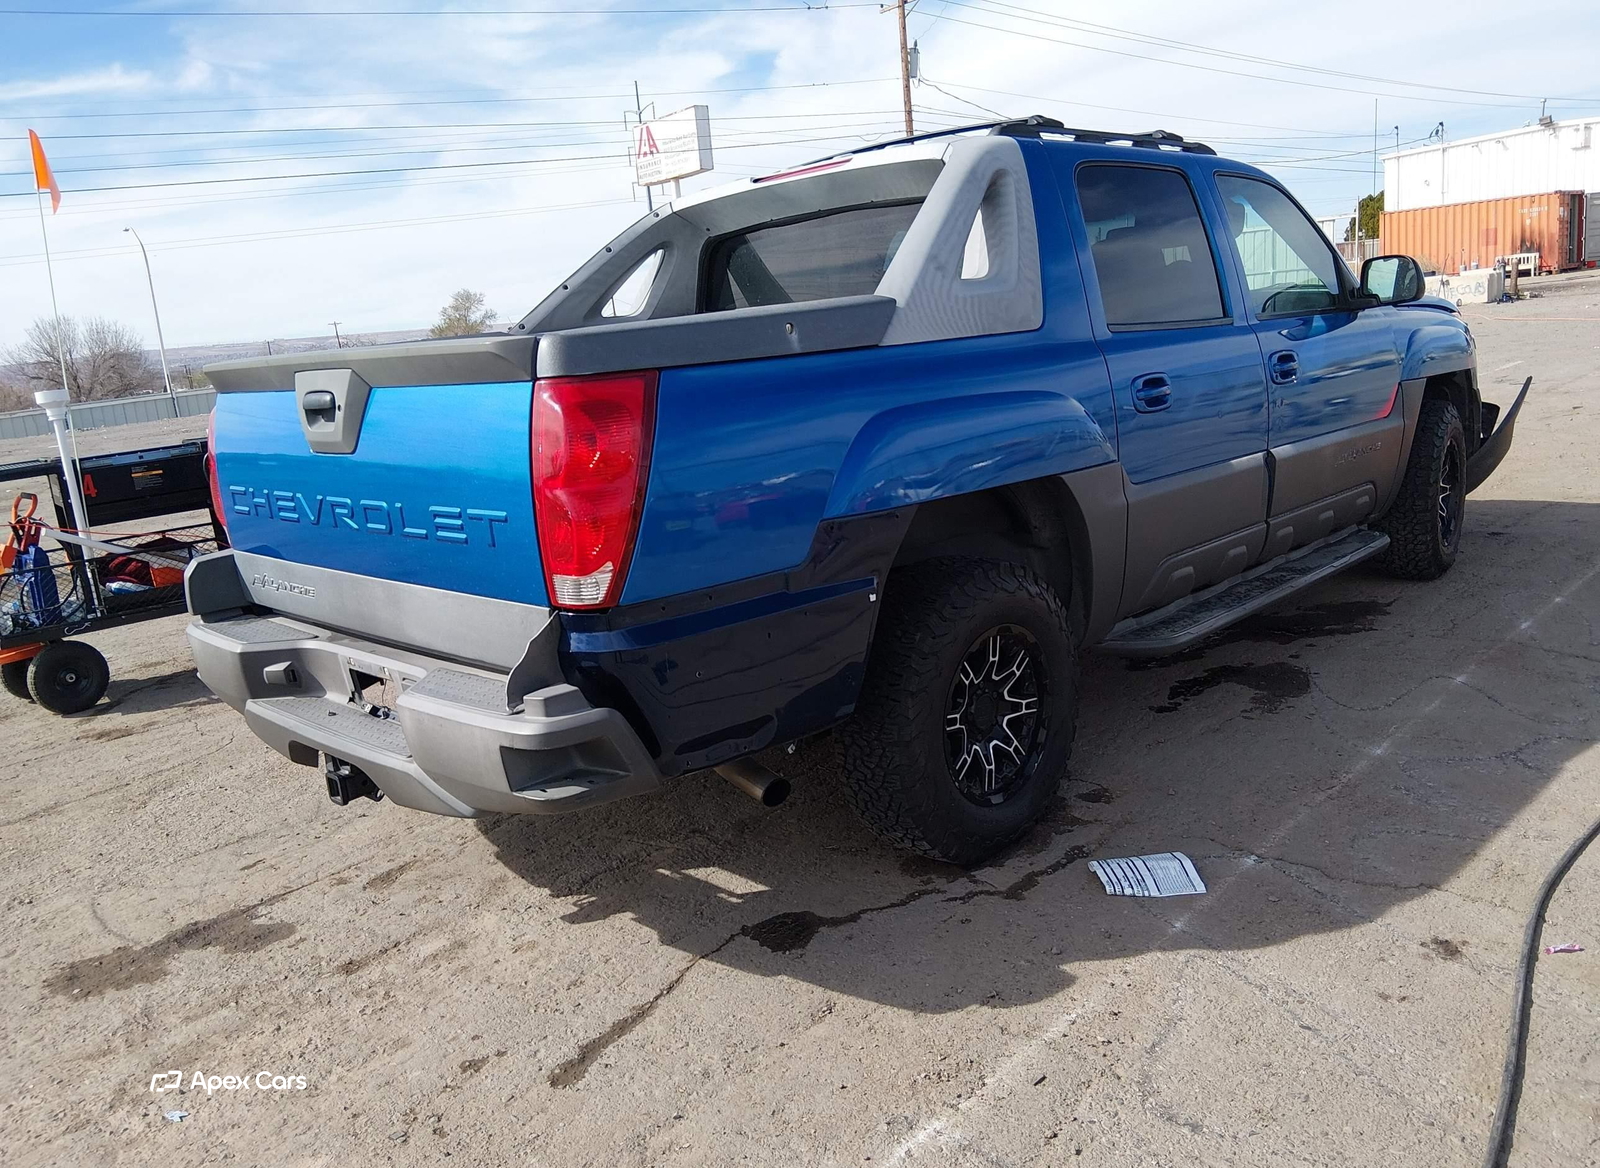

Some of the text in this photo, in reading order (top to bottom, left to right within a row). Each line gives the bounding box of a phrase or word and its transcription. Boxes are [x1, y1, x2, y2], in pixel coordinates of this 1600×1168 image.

[83, 473, 98, 498] 4
[229, 484, 508, 548] CHEVROLET
[251, 571, 317, 599] AVALANCHE
